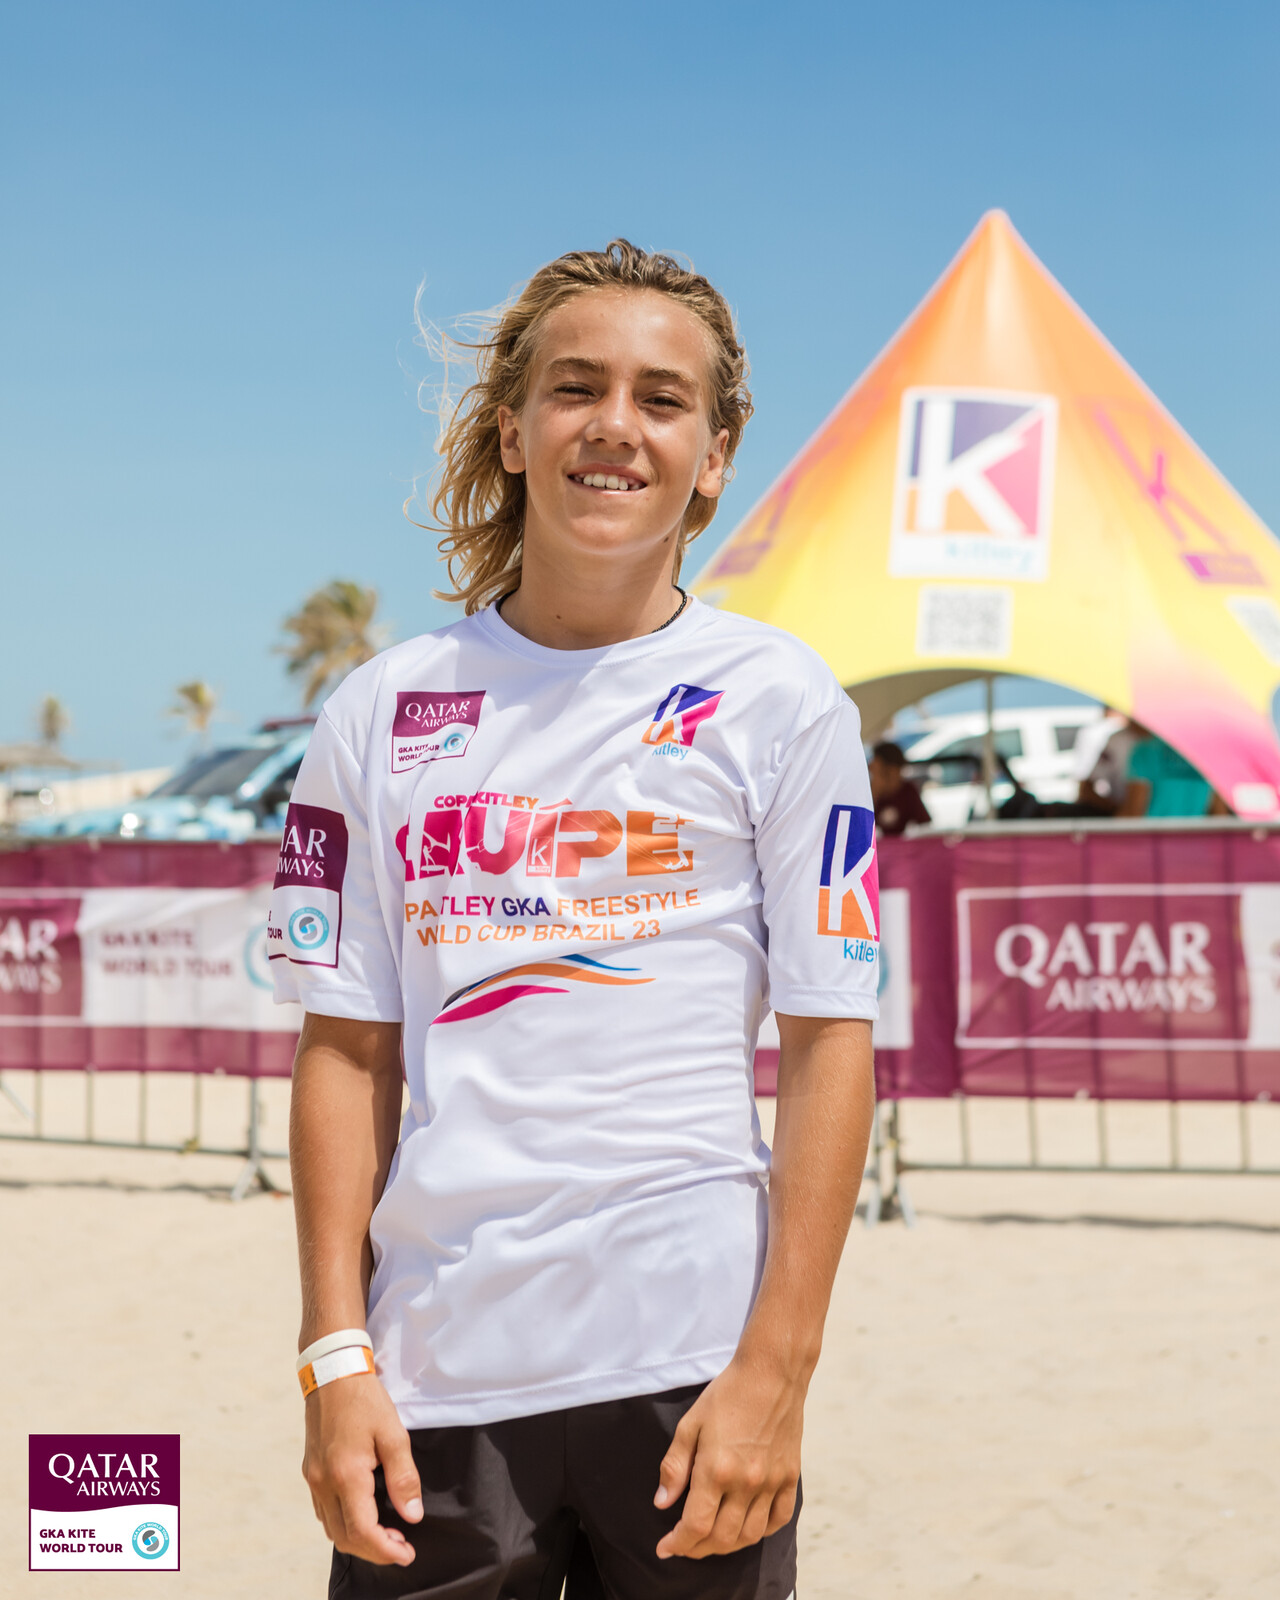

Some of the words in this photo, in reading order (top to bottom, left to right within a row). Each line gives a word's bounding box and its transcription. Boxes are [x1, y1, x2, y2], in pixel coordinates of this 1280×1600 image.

[405, 701, 470, 721] QATAR
[276, 856, 325, 880] WAYS
[501, 897, 551, 917] GKA
[557, 888, 701, 918] FREESTYLE
[477, 924, 527, 942] CUP
[532, 924, 625, 942] BRAZIL
[632, 919, 661, 940] 23
[994, 920, 1214, 988] QATAR
[1045, 976, 1217, 1013] AIRWAYS
